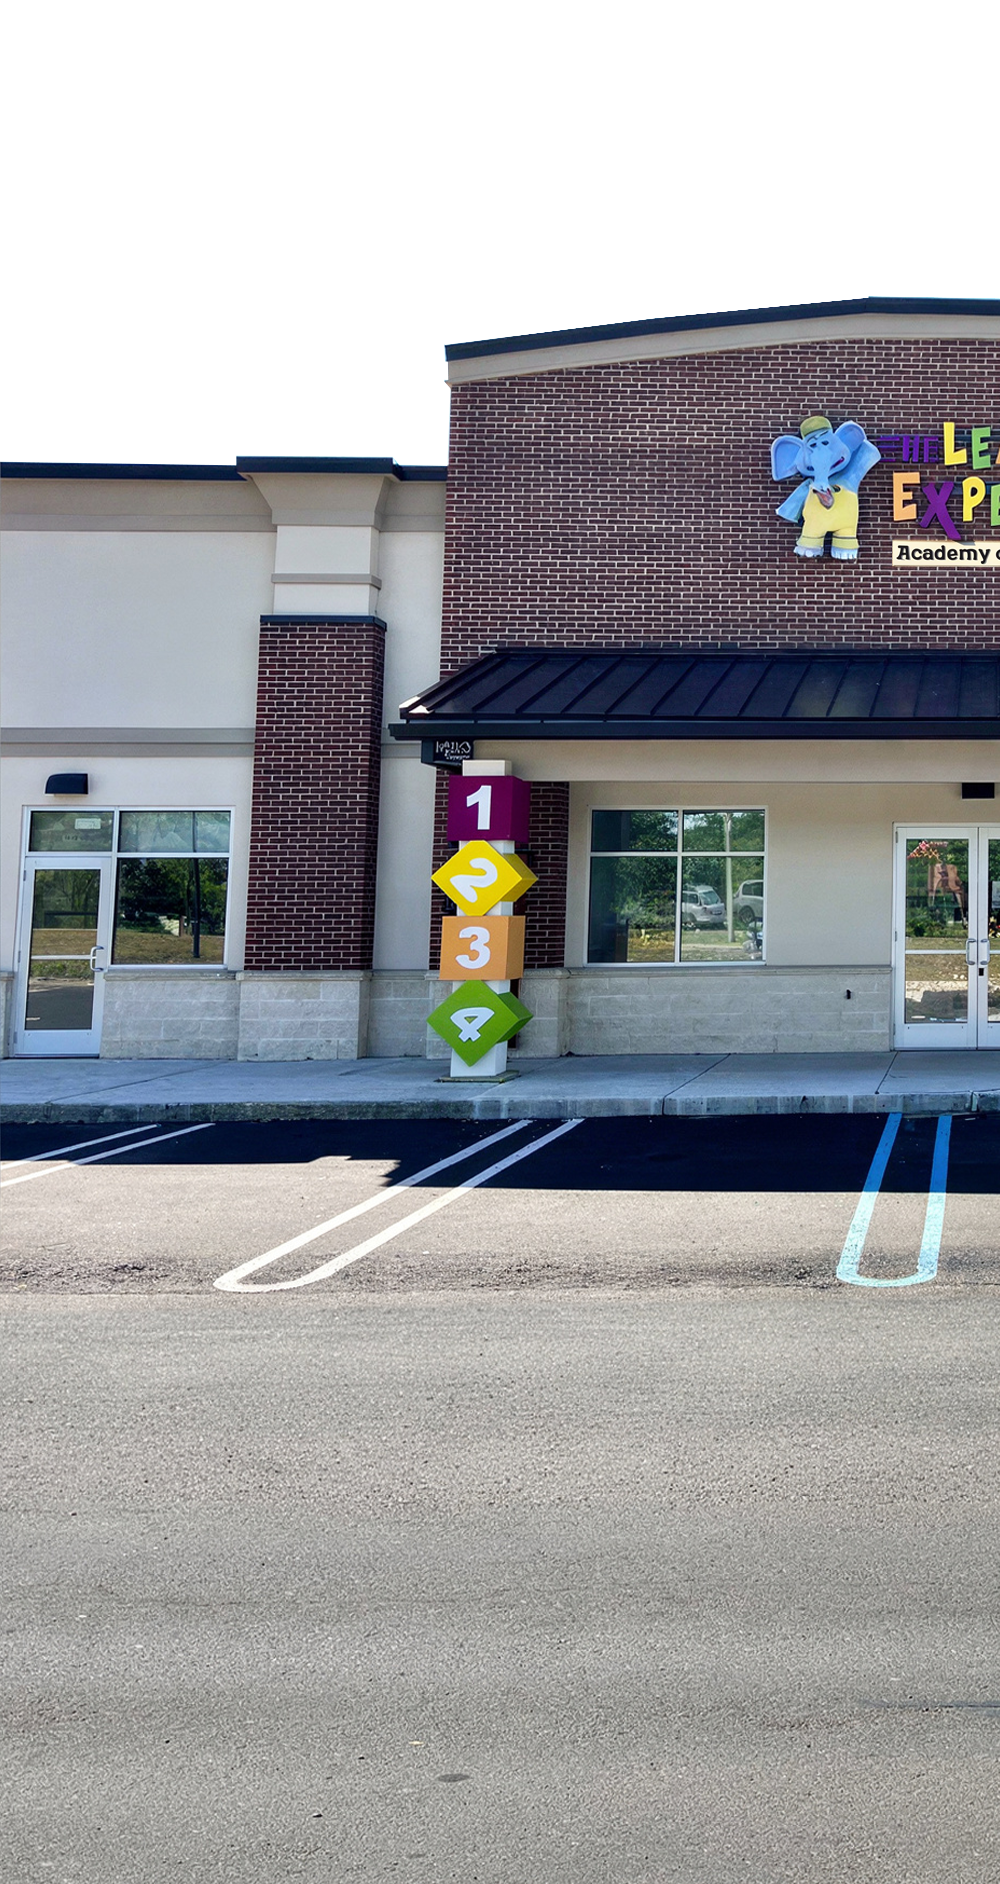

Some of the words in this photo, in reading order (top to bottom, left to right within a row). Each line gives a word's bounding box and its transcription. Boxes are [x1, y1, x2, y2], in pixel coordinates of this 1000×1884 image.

[896, 545, 991, 564] Academy
[466, 785, 492, 830] 1
[450, 857, 498, 903] 2
[455, 926, 491, 969] 3
[450, 1007, 495, 1042] 4
